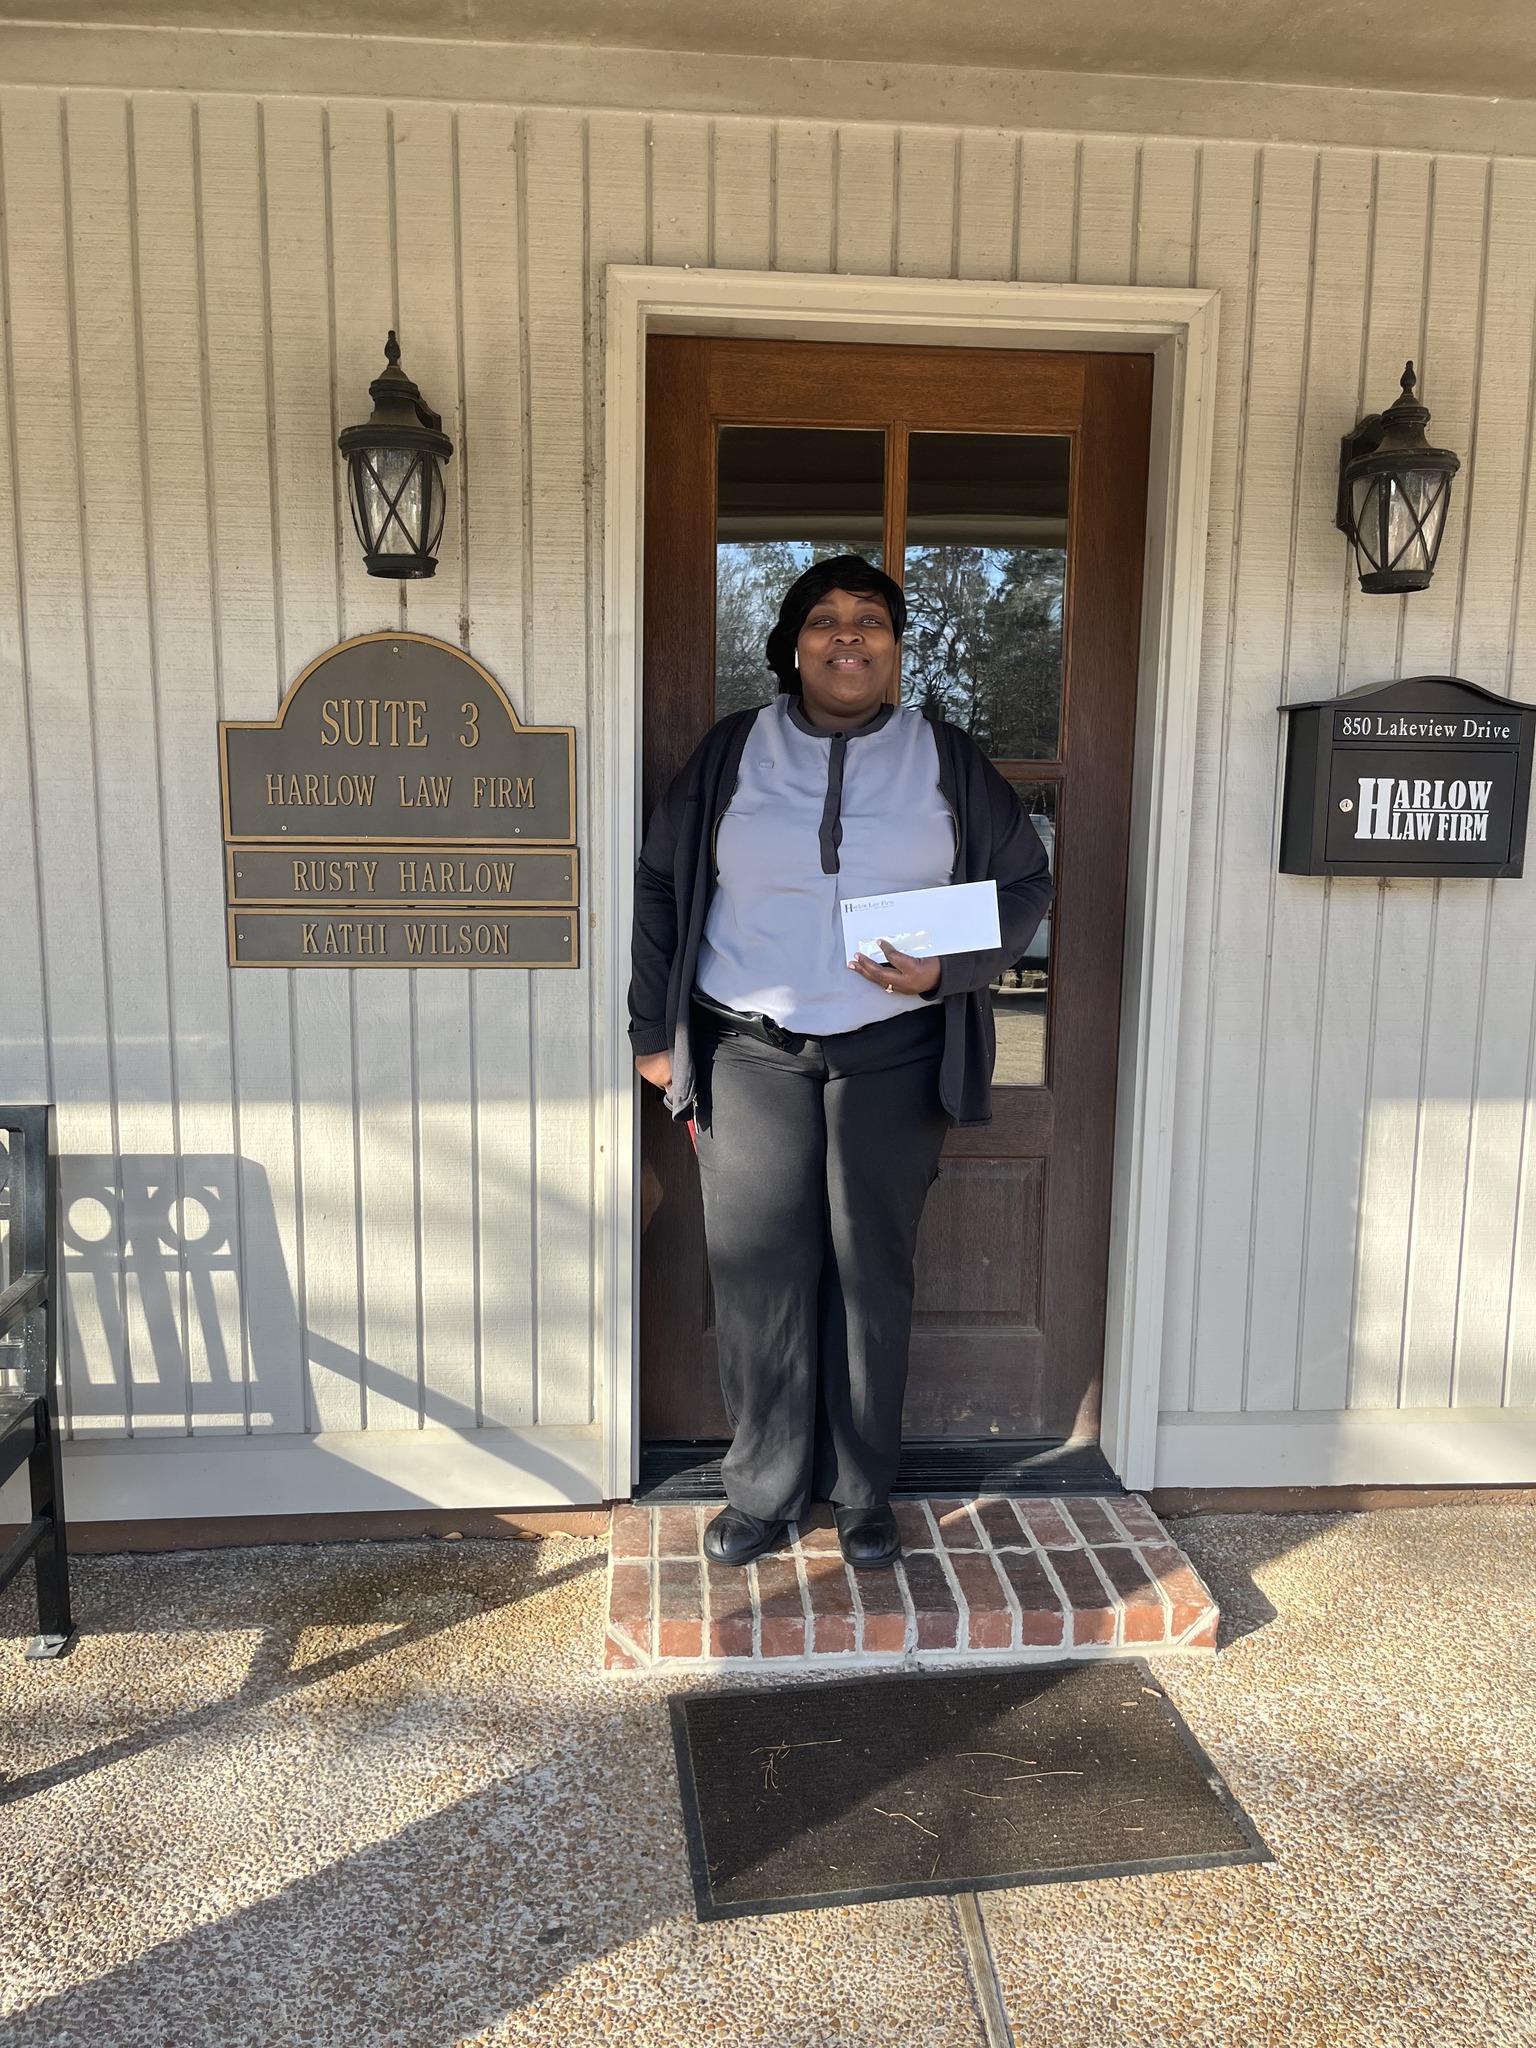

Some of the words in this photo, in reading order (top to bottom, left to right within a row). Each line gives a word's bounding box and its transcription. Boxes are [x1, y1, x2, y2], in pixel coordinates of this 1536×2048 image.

[320, 699, 429, 747] SUITE
[459, 702, 481, 748] 3
[1342, 717, 1372, 736] 850
[1376, 718, 1457, 738] Lakeview
[1462, 719, 1511, 739] Drive
[265, 774, 376, 806] HARLOW
[398, 776, 452, 808] LAW
[472, 777, 536, 809] FIRM
[1354, 777, 1493, 840] HARLOW
[1391, 812, 1434, 841] LAW
[1436, 813, 1489, 842] FIRM
[292, 860, 379, 892] RUSTY
[398, 862, 516, 894] HARLOW
[301, 923, 388, 955] KATHI
[403, 924, 510, 956] WILSON
